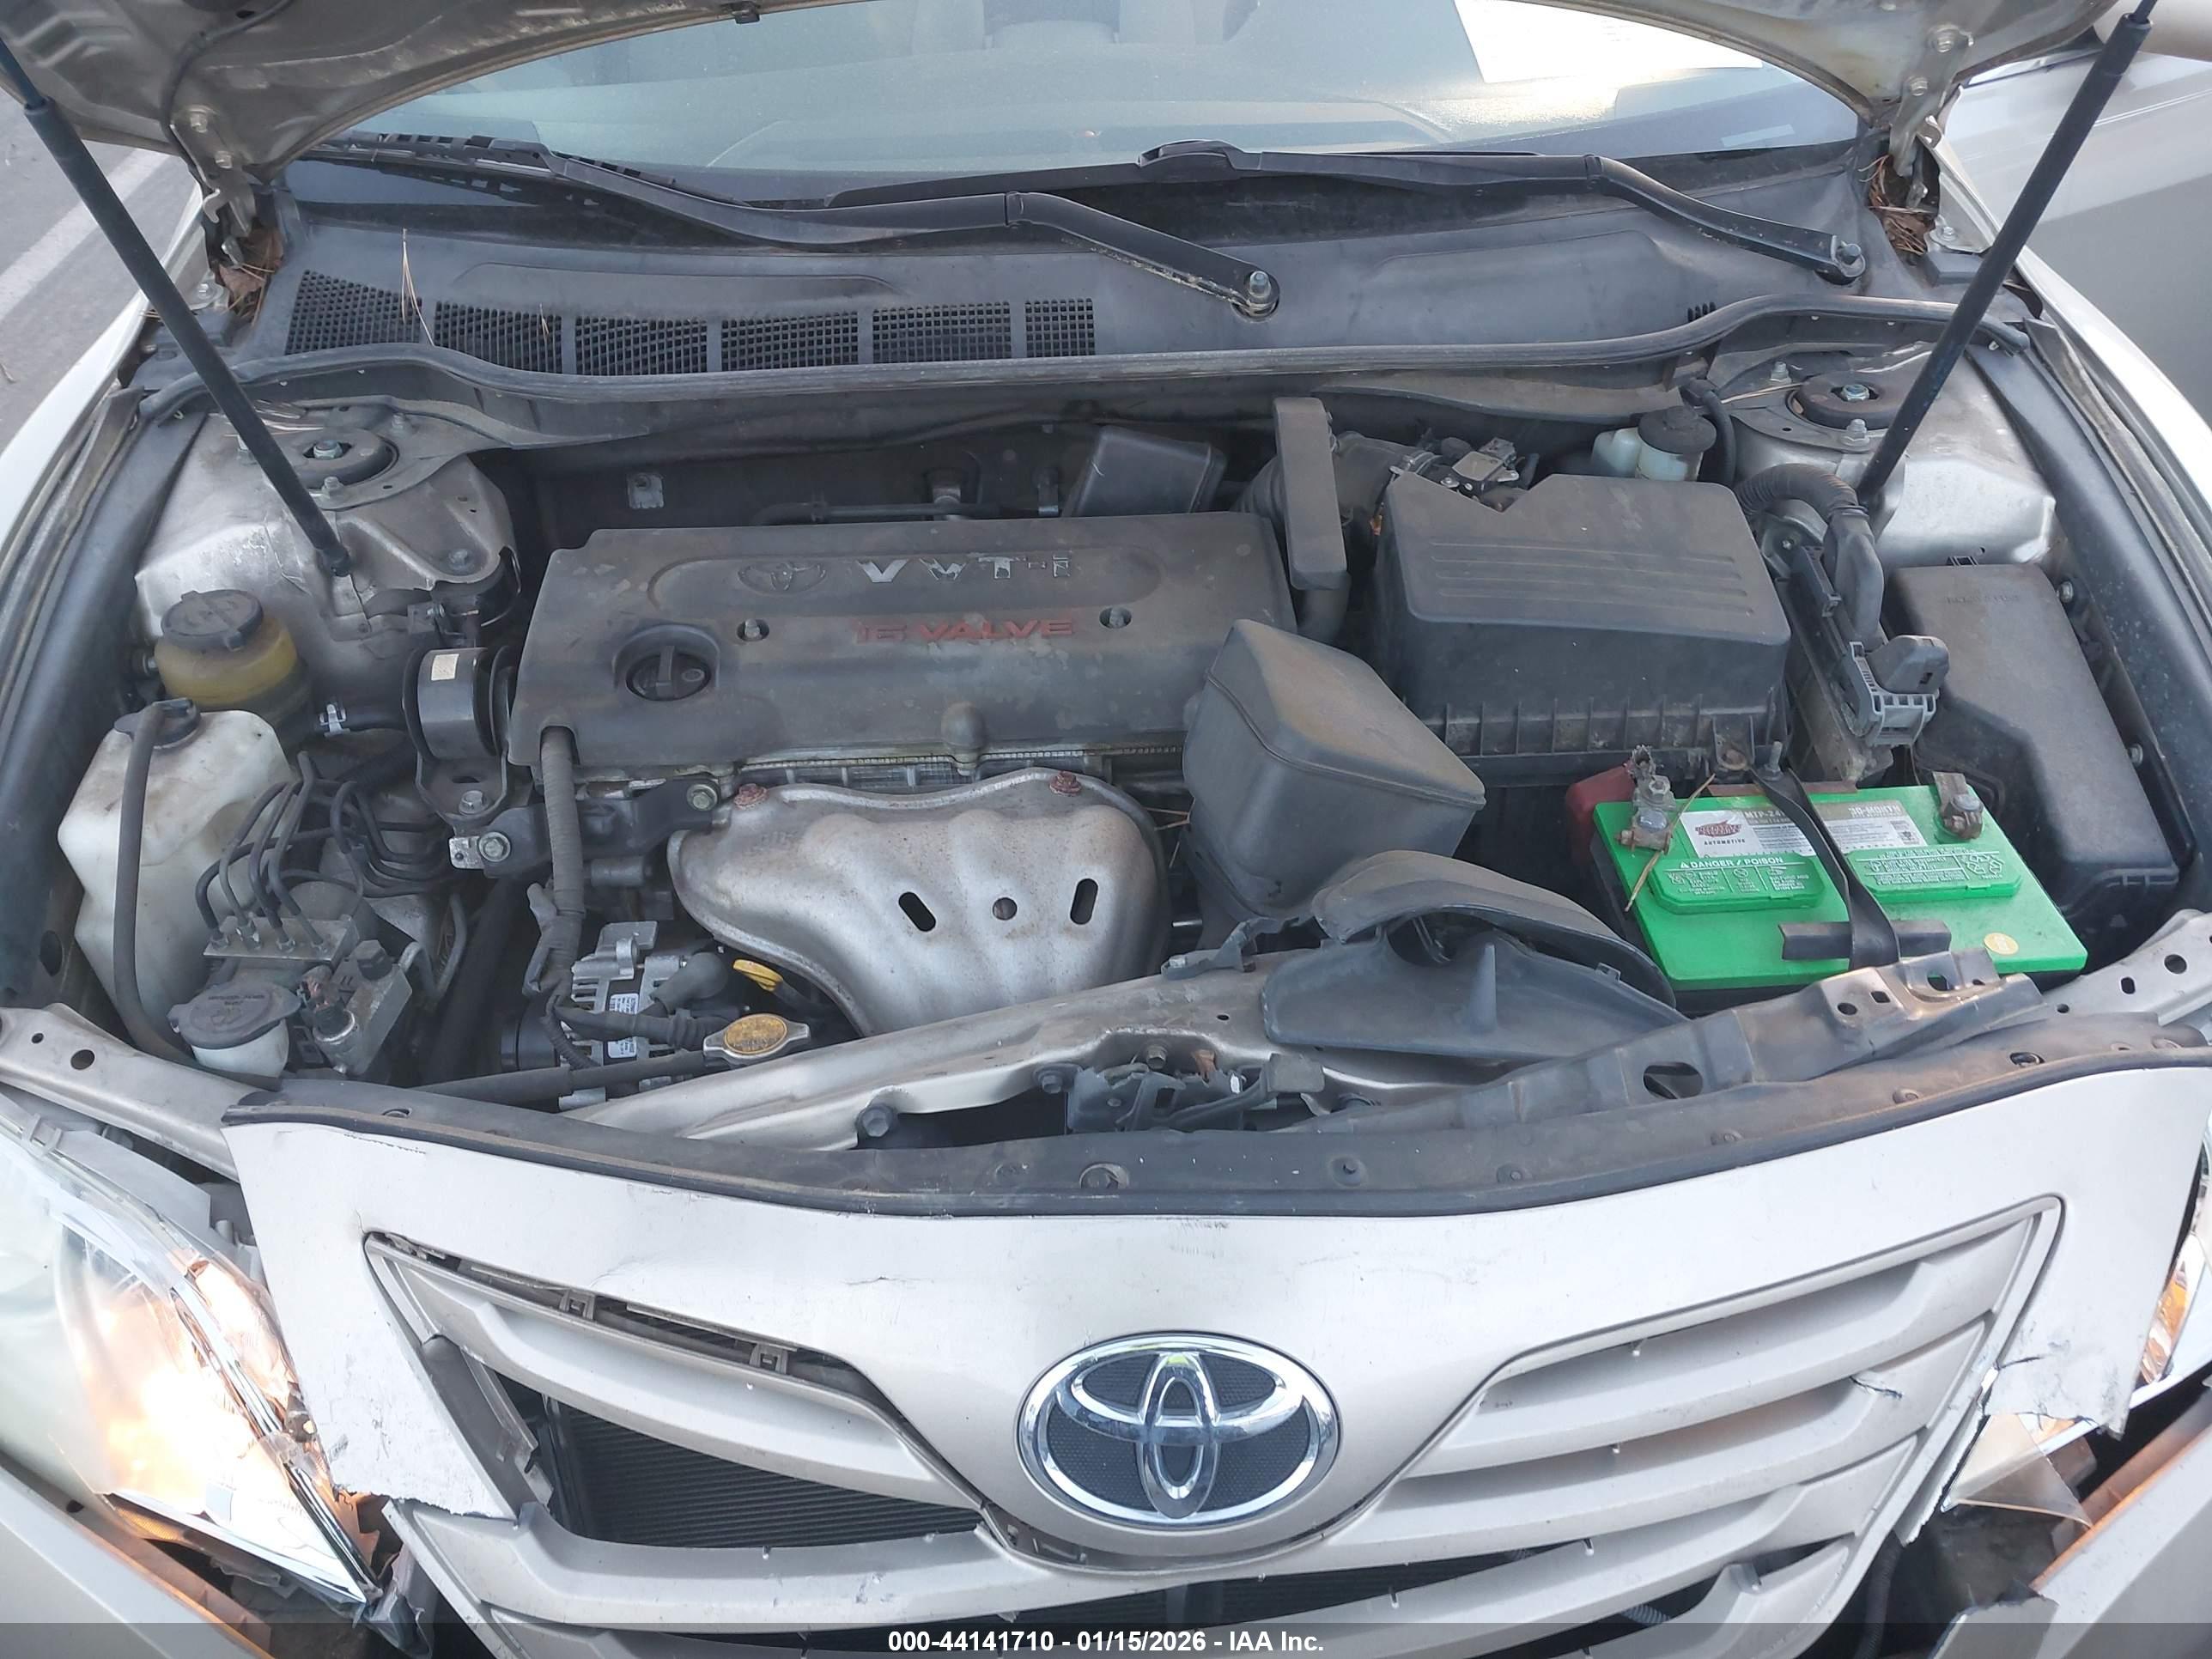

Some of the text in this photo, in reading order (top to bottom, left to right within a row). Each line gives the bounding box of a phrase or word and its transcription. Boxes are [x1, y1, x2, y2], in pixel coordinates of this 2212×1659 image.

[918, 619, 1073, 640] VALVE
[1690, 860, 1735, 869] DANGER
[1745, 857, 1784, 866] POISON
